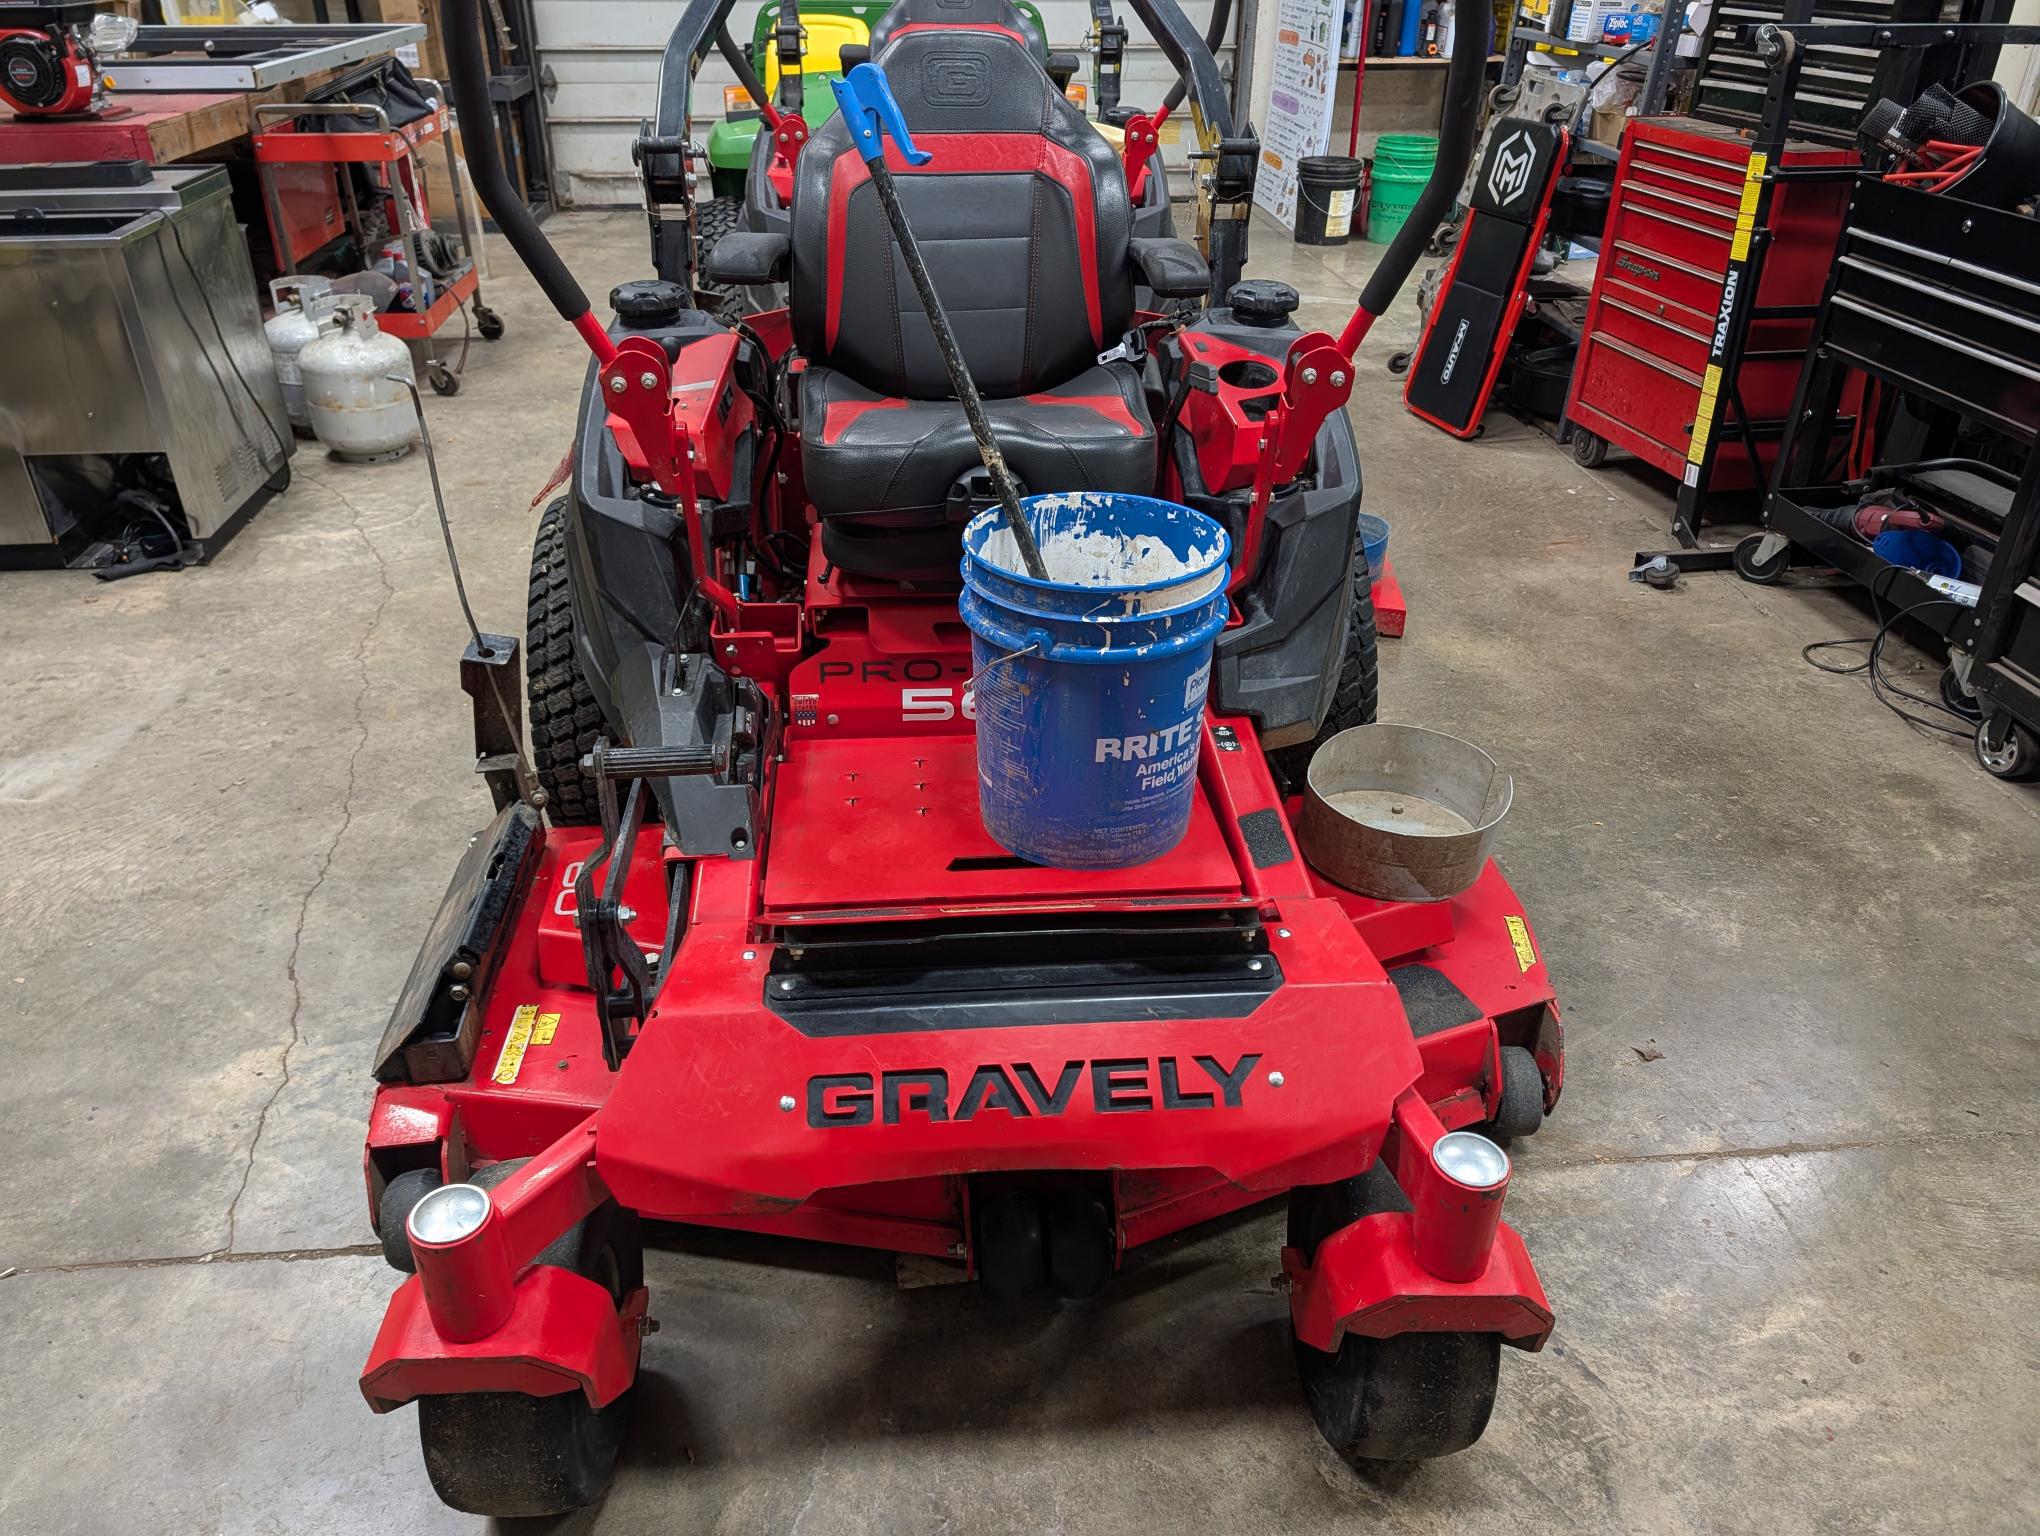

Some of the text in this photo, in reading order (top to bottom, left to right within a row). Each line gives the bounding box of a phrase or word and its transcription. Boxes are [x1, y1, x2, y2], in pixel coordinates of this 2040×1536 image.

[1608, 17, 1629, 31] Ziploc
[1711, 269, 1740, 358] TRAXION
[902, 688, 977, 722] 5
[1094, 715, 1194, 763] BRITE
[1135, 743, 1196, 777] America's
[806, 1052, 1265, 1129] GRAVELY
